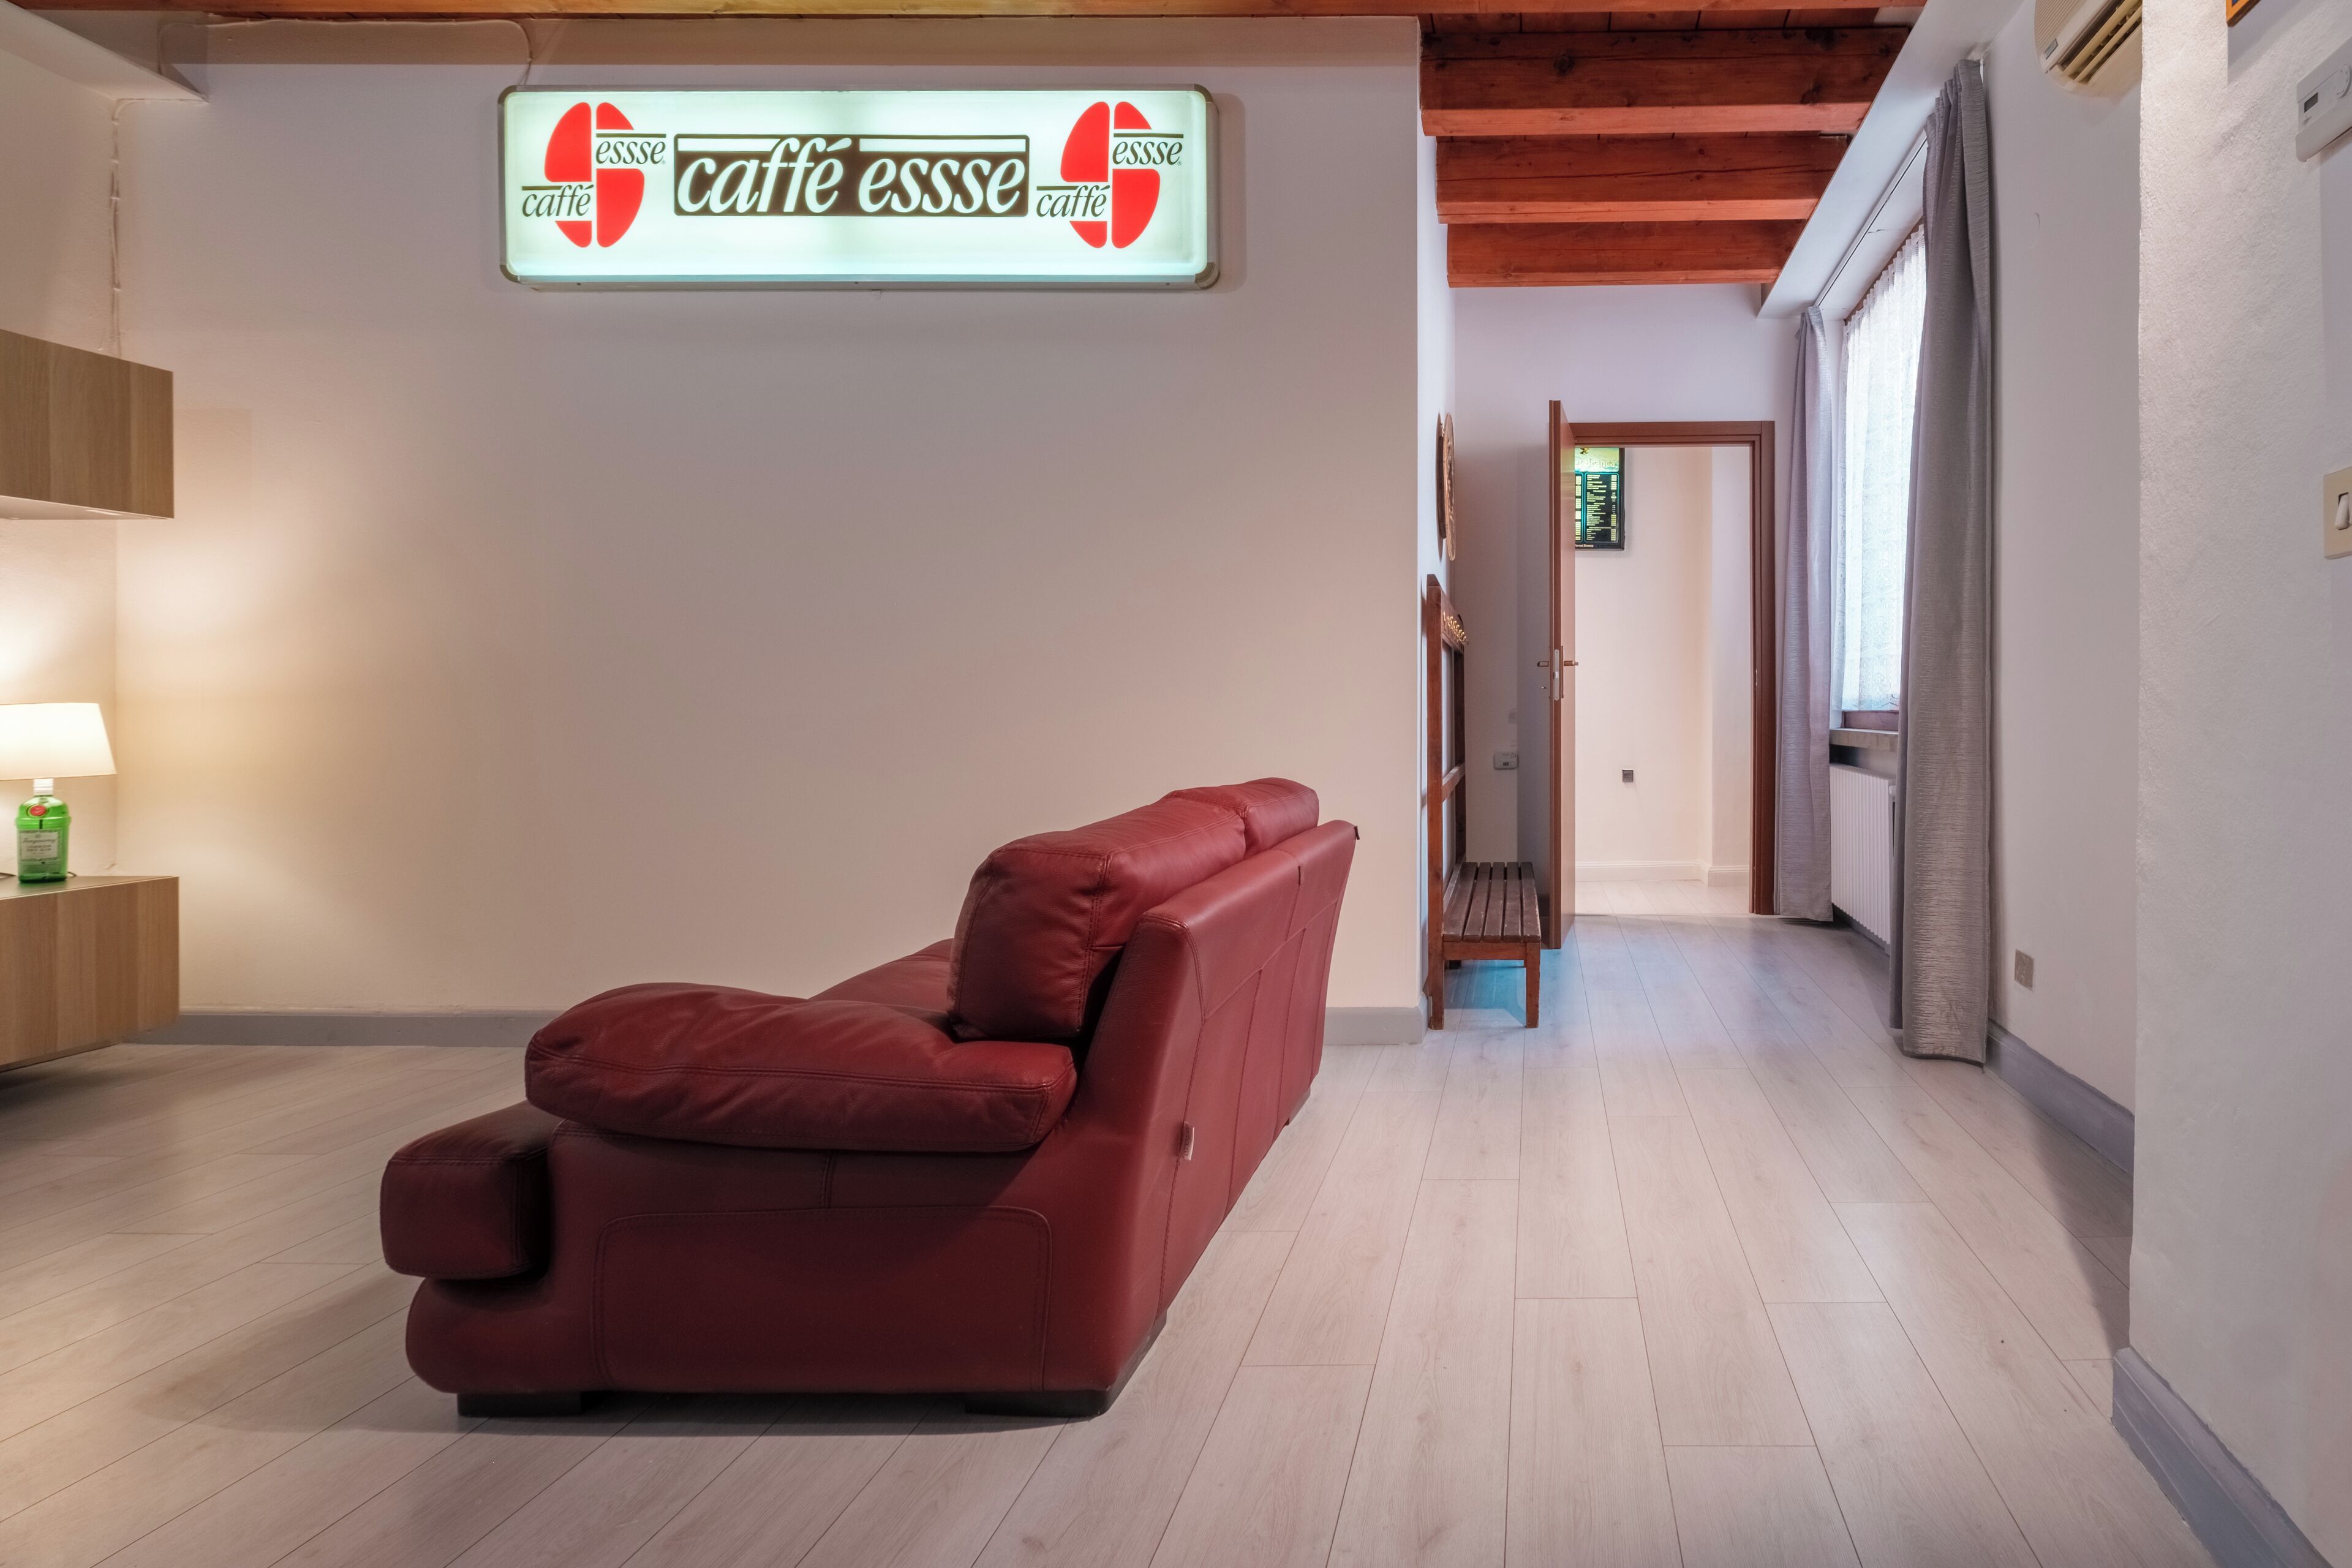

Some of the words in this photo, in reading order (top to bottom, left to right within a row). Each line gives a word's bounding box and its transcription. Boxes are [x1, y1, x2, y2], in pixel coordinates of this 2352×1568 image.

[596, 141, 666, 165] essse
[1112, 141, 1183, 165] essse
[677, 137, 852, 213] caffé
[859, 158, 1026, 214] essse
[522, 184, 594, 217] caffé
[1036, 184, 1110, 217] caffé
